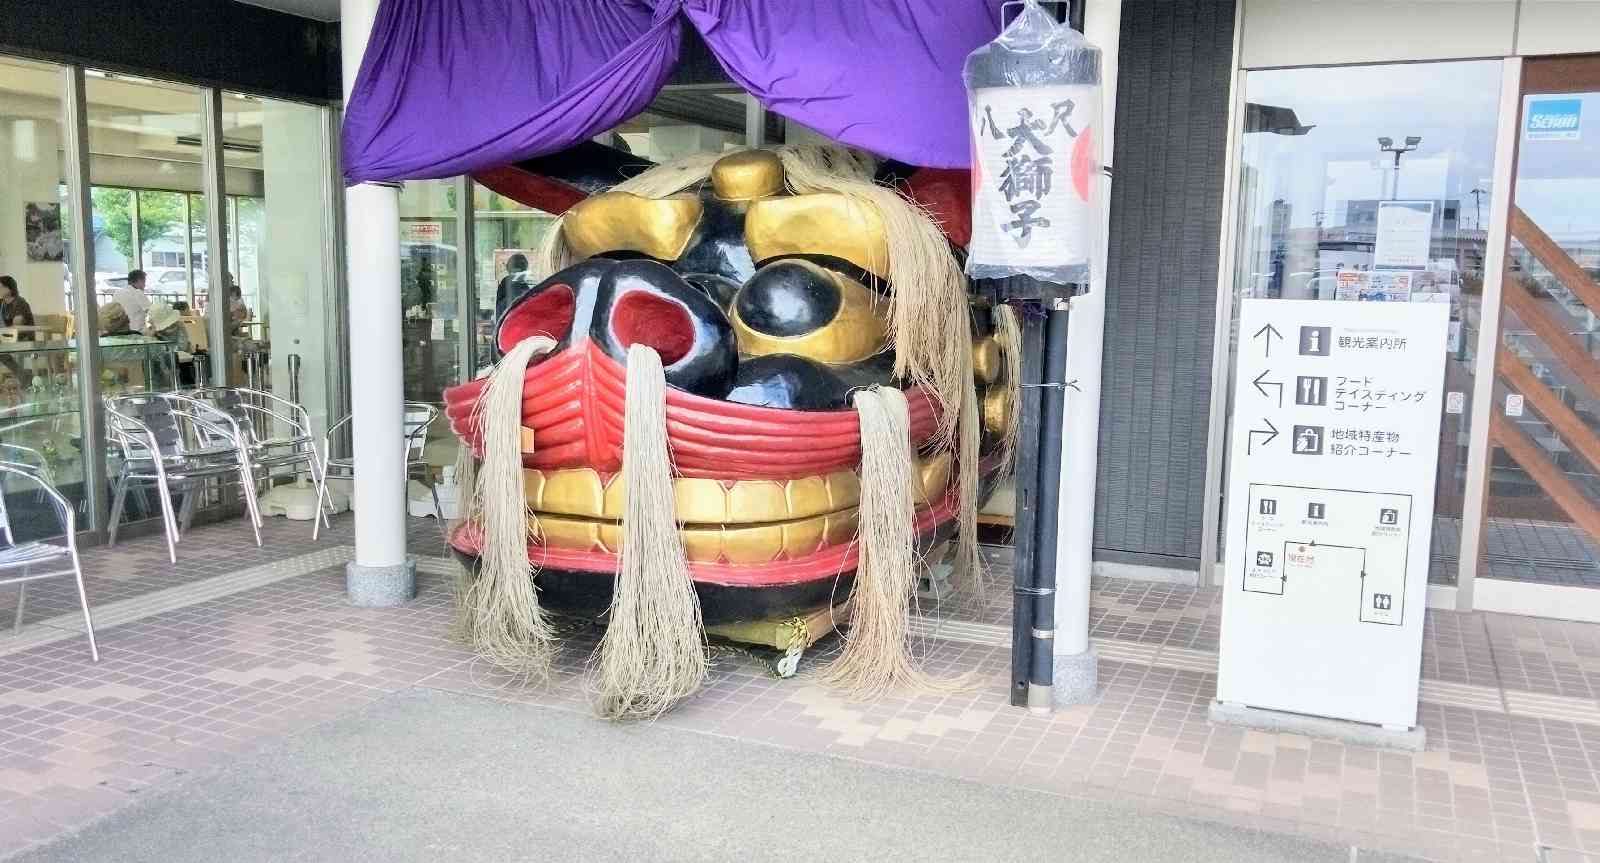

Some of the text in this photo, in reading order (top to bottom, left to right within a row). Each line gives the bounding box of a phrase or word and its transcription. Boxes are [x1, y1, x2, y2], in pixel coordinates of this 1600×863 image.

[1338, 336, 1407, 352] 観光案内所
[1336, 376, 1372, 387] フード
[1335, 388, 1426, 403] テイスティング
[1335, 401, 1387, 411] コーナー
[1332, 428, 1401, 443] 地域特産物
[1330, 443, 1411, 457] 紹介コーナー
